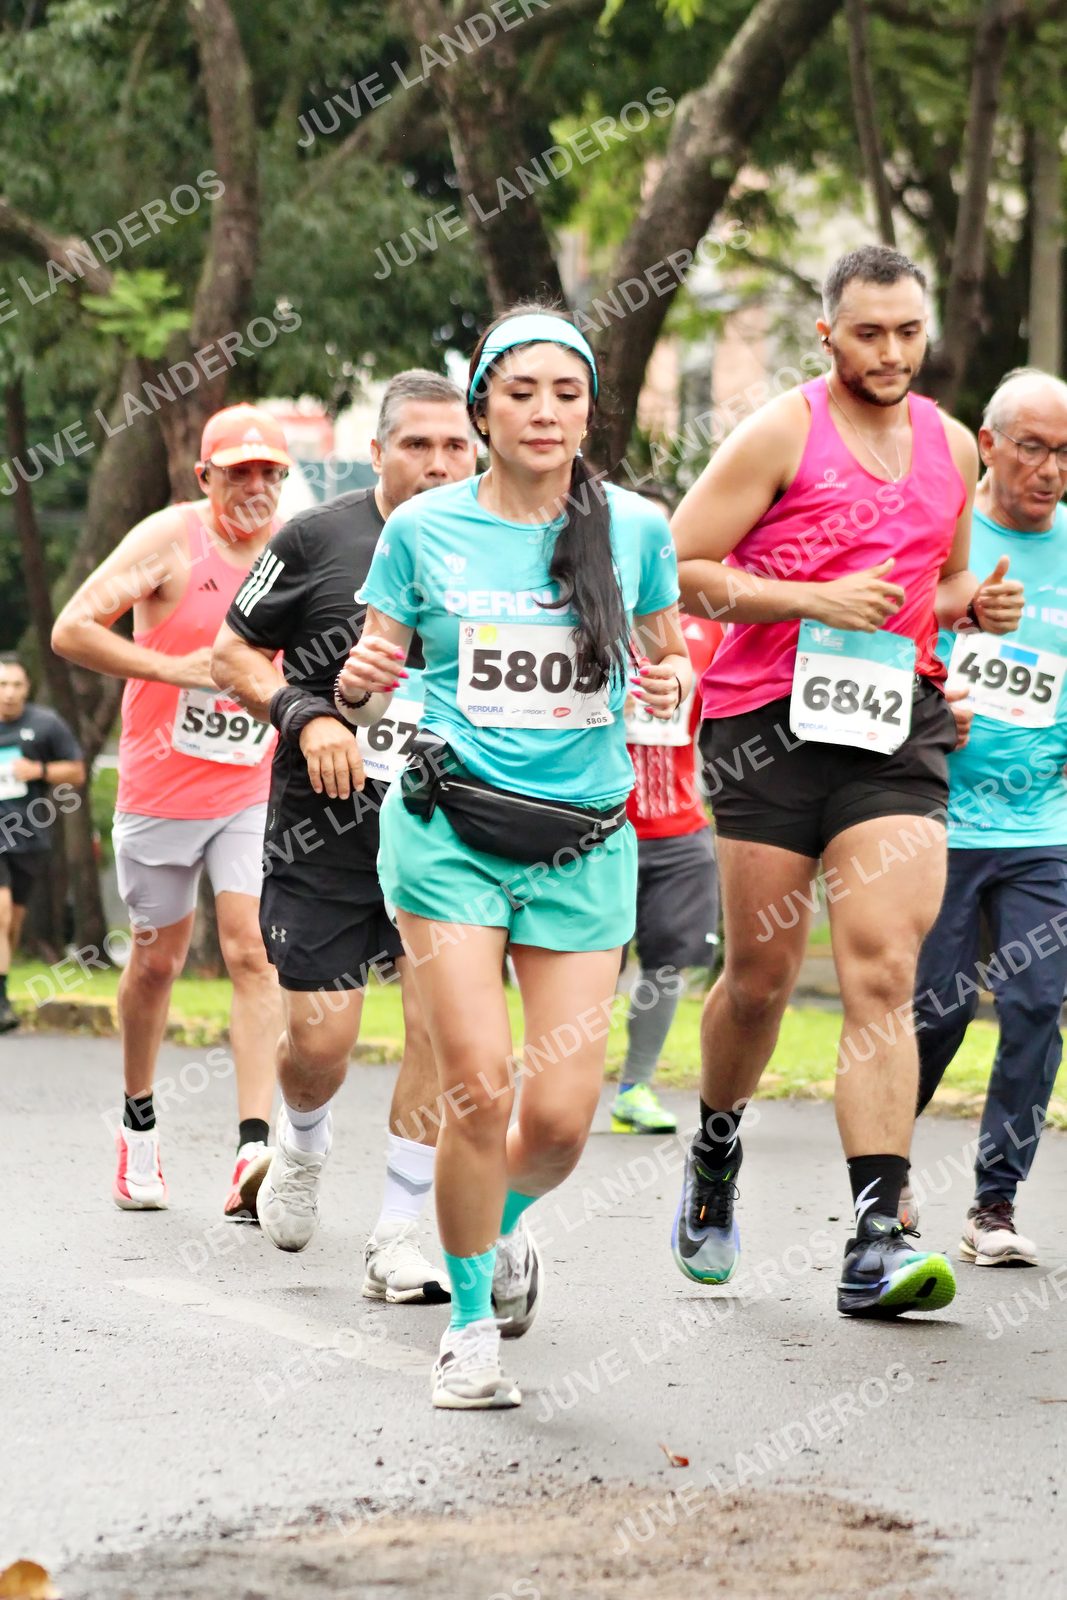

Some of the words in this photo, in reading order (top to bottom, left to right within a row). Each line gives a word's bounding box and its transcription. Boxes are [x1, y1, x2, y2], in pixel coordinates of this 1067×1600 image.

[957, 651, 1056, 704] 4995
[467, 704, 504, 714] PERDURA
[586, 716, 608, 725] 5805
[803, 675, 903, 727] 6842
[182, 705, 271, 745] 5997
